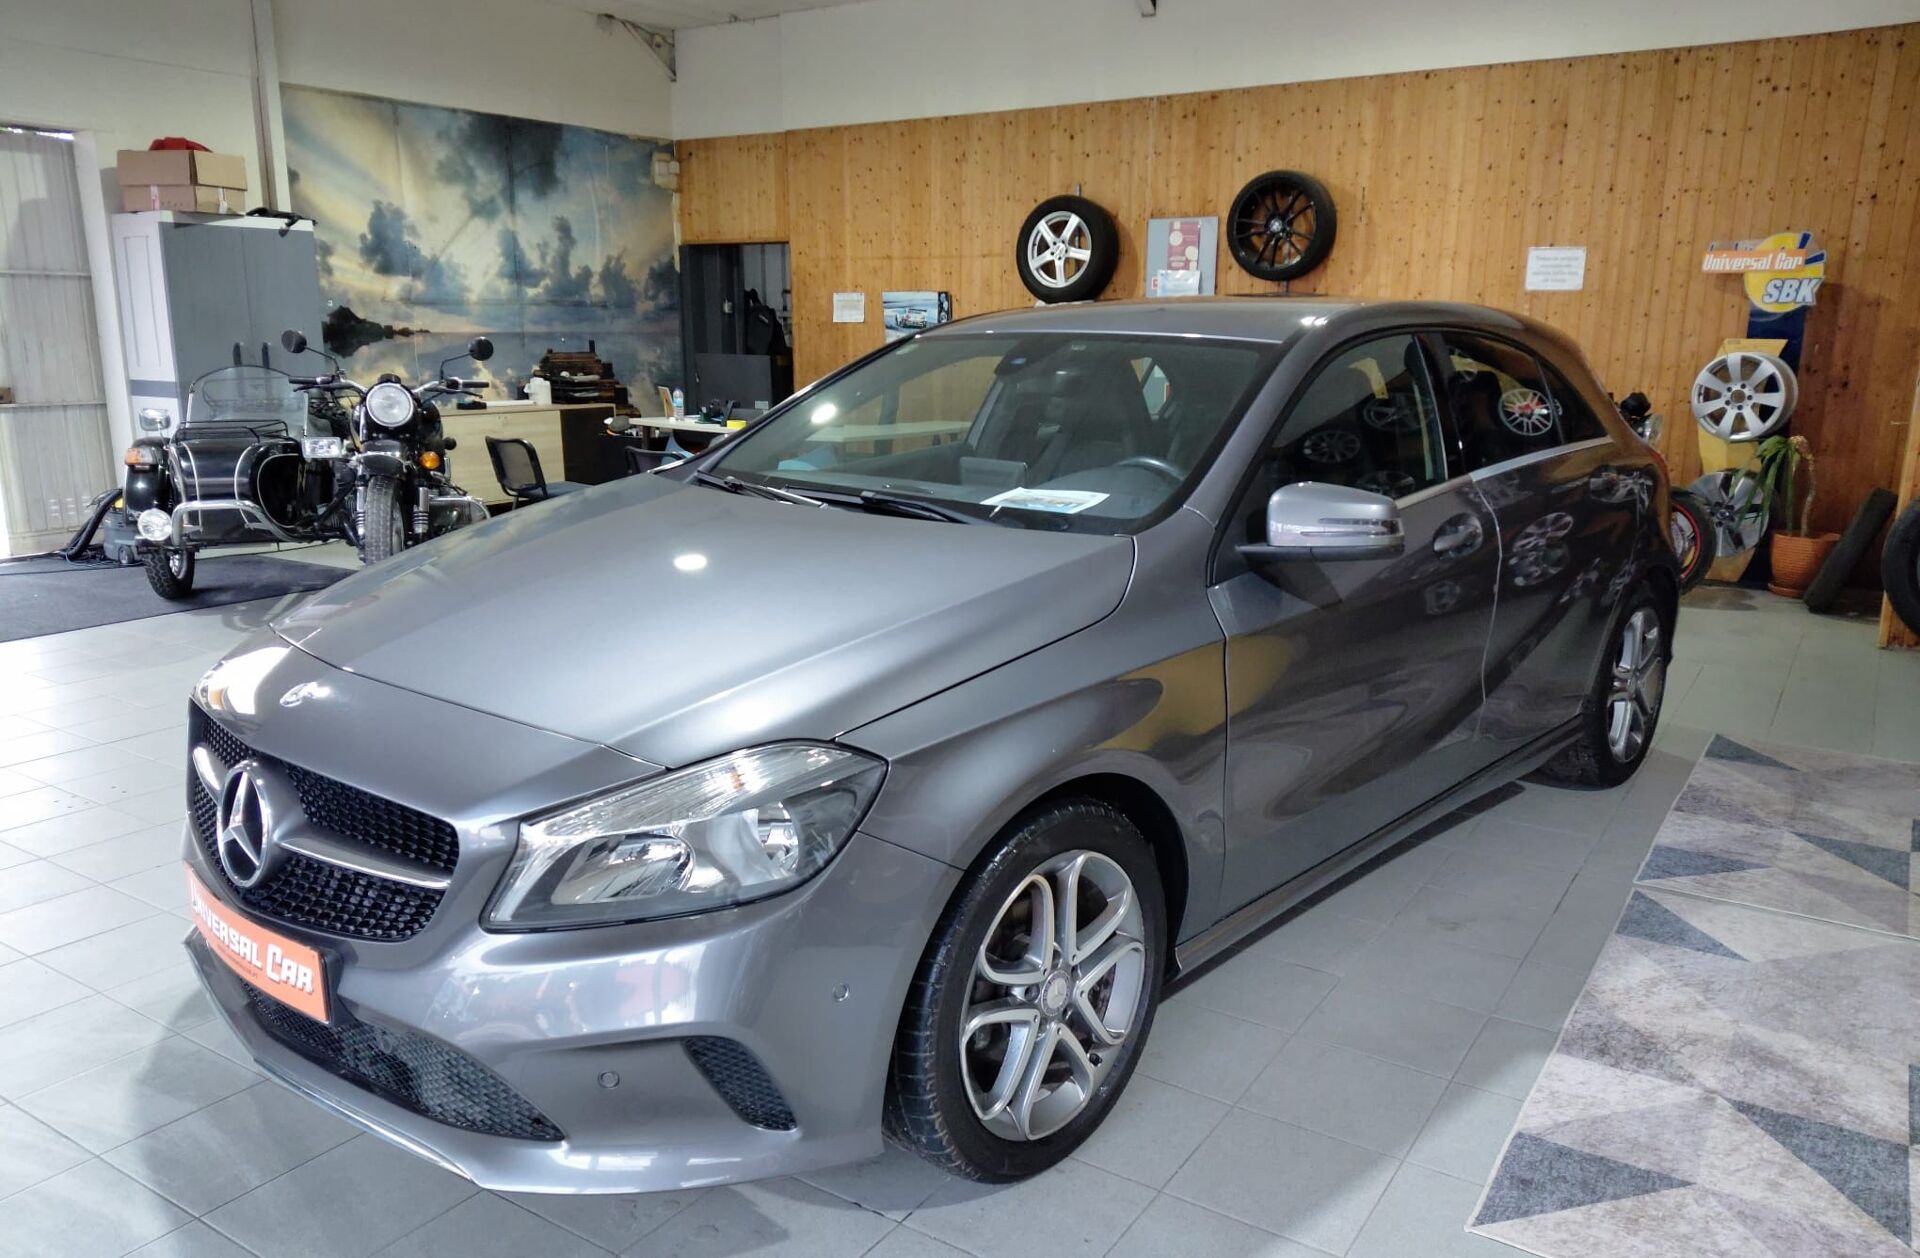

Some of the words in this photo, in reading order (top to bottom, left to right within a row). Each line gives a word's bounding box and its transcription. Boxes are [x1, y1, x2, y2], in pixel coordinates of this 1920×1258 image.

[1702, 253, 1773, 271] Universal
[1775, 252, 1804, 270] Car
[1762, 278, 1824, 304] SBK
[190, 879, 262, 970] UNIVERSAL
